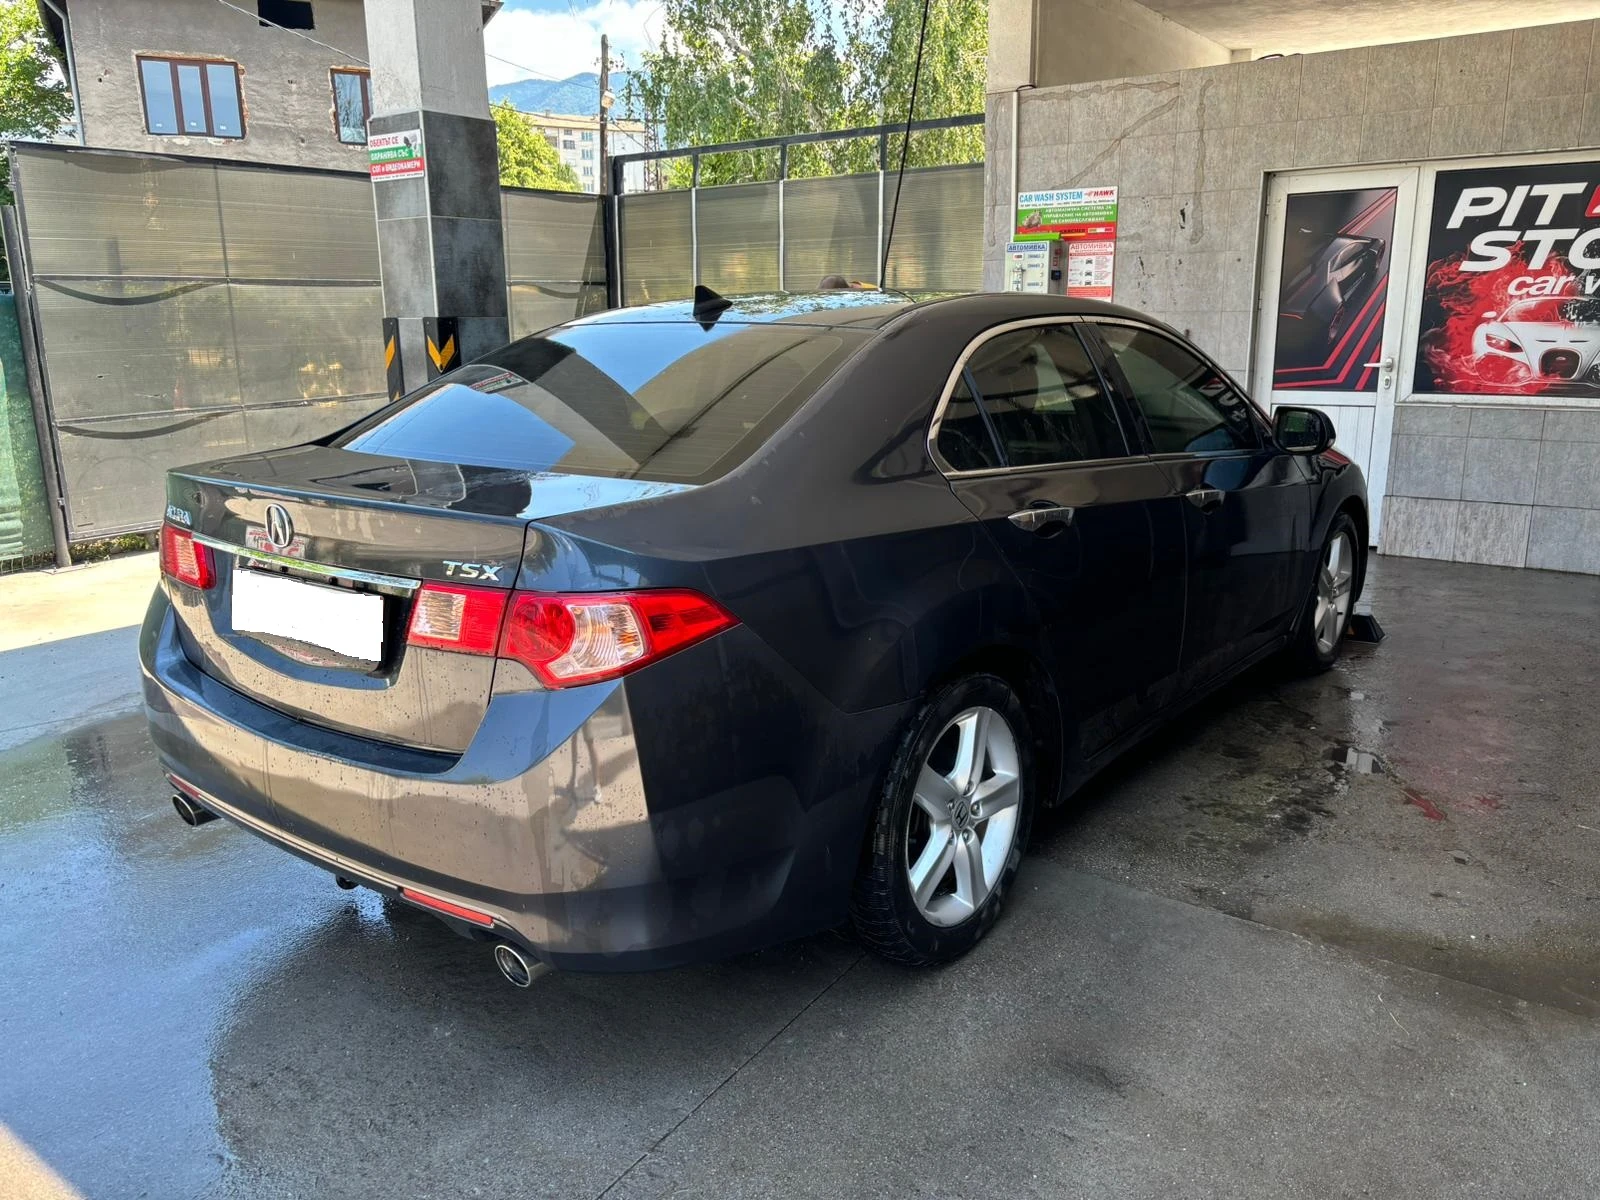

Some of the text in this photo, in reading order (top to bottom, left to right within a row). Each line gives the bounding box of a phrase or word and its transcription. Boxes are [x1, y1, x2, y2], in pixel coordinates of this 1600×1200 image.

[392, 136, 399, 144] СЕ
[1019, 191, 1083, 203] CAR WASH SYSTEM
[1093, 189, 1115, 197] HAWK
[1446, 182, 1588, 229] PIT
[1507, 275, 1576, 296] car
[442, 560, 504, 582] TSX
